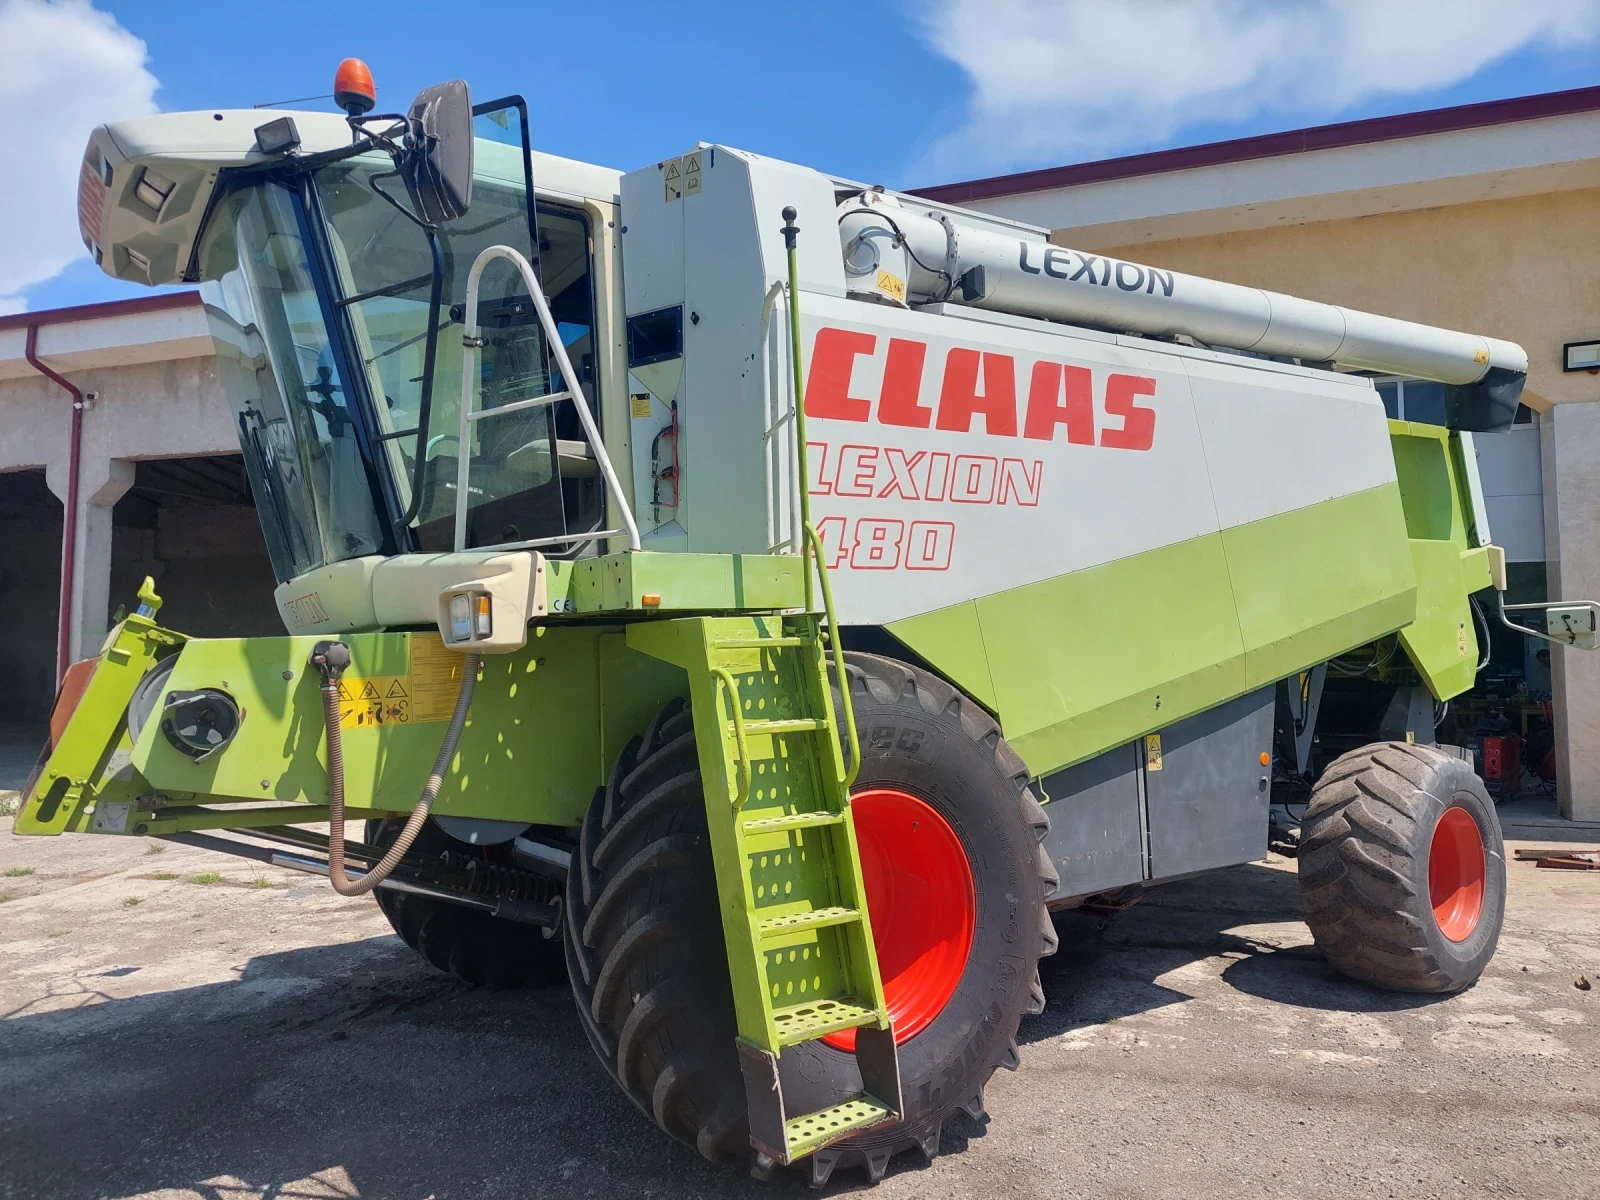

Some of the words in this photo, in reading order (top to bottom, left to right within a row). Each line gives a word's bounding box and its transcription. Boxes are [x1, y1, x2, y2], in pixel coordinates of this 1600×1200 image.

[1019, 241, 1175, 298] LEXION
[803, 326, 1157, 451] CLAAS
[804, 441, 1043, 506] LEXION
[801, 516, 956, 571] 480
[553, 599, 571, 612] CE
